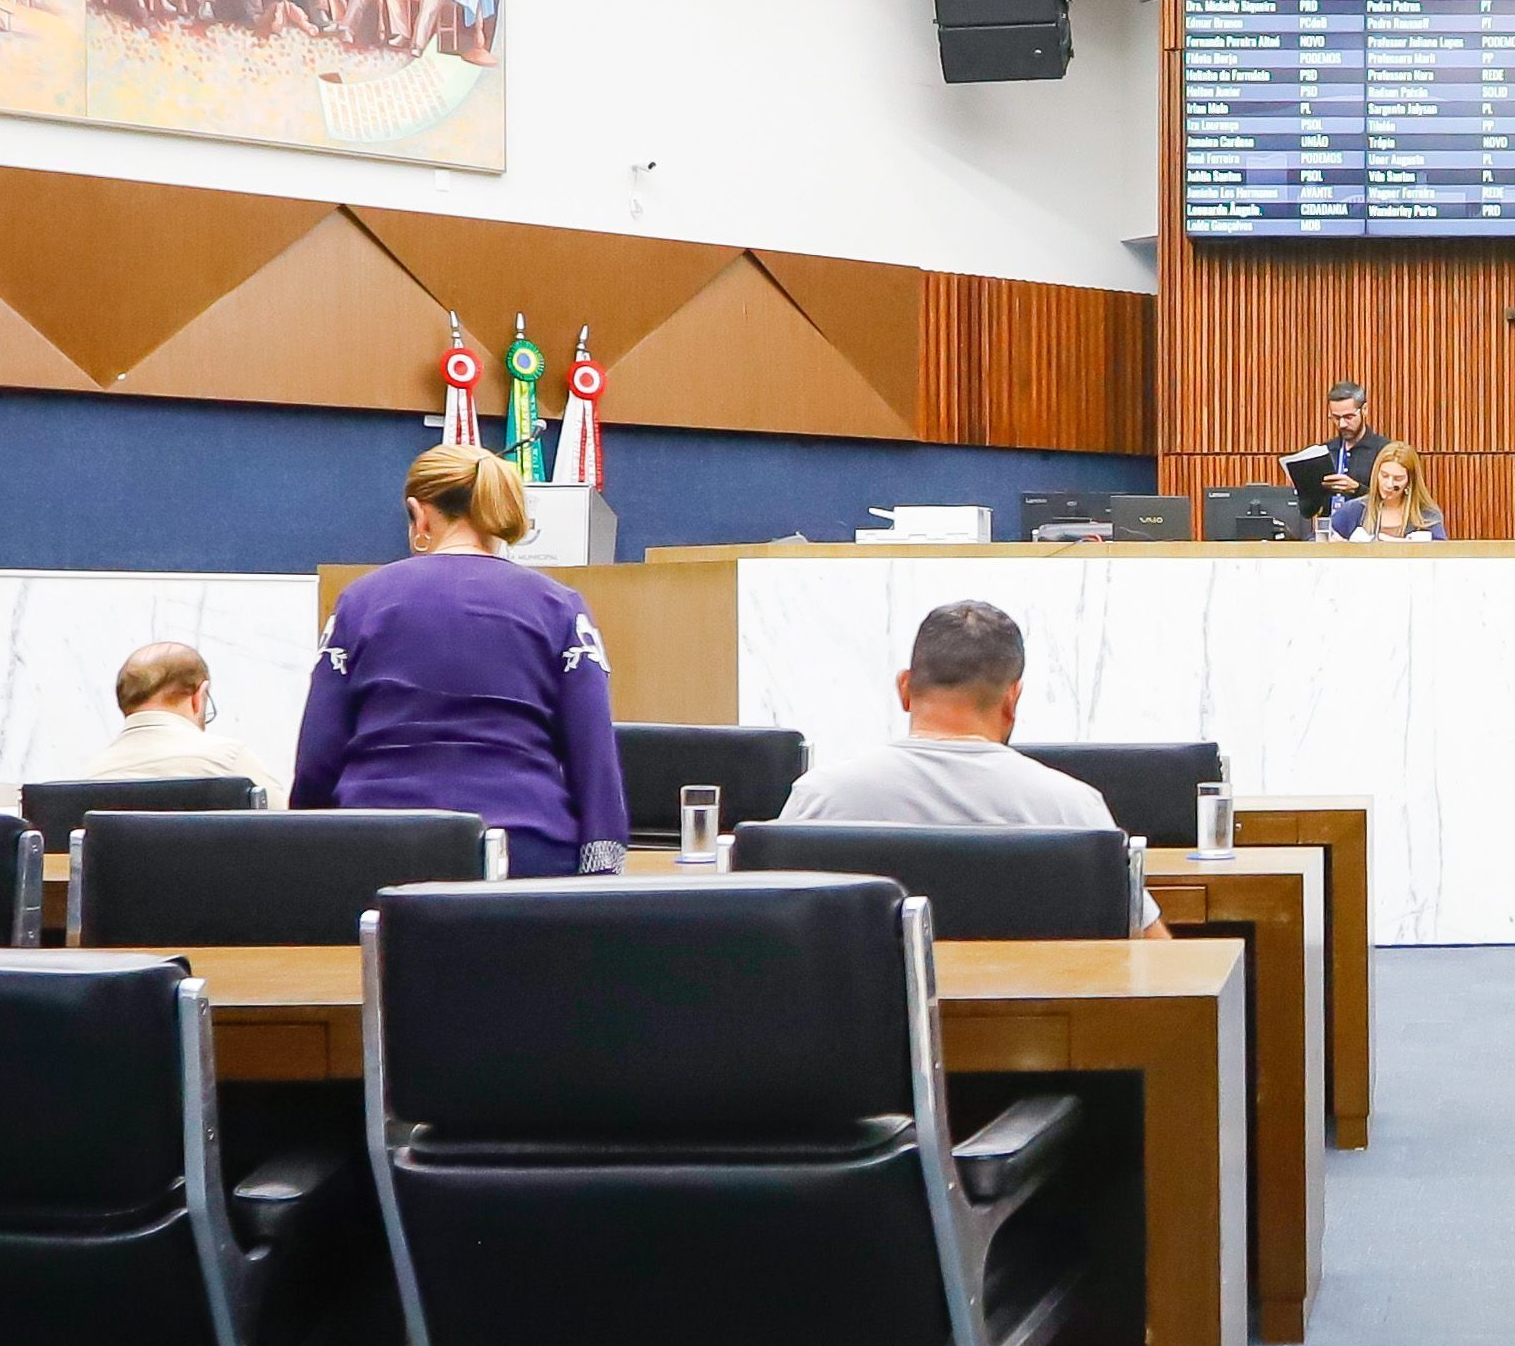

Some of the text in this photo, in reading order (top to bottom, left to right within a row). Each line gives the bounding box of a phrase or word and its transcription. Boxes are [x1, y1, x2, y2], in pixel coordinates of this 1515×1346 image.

[1481, 0, 1492, 12] PT
[1481, 18, 1492, 29] PT
[1300, 36, 1325, 47] NOVO
[1300, 53, 1341, 64] PODEMOS
[1482, 53, 1494, 64] PP
[1299, 70, 1318, 81] PSD
[1482, 69, 1505, 81] REDE
[1300, 86, 1318, 97] PSD
[1482, 87, 1508, 98] SOLID
[1301, 103, 1312, 114] PL
[1482, 104, 1493, 115] PL
[1301, 119, 1323, 131] PSOL
[1482, 120, 1494, 131] PP
[1301, 134, 1329, 148] UNIÃO
[1482, 137, 1508, 148] NOVO
[1301, 153, 1343, 164] PODEMOS
[1482, 154, 1493, 165] PL
[1301, 170, 1323, 182] PSOL
[1482, 170, 1494, 182] PL
[1301, 187, 1333, 198] AVANTE
[1482, 187, 1504, 199] REDE
[1301, 204, 1349, 215] CIDADANIA
[1482, 205, 1501, 217] PRD
[1301, 220, 1321, 231] MDB
